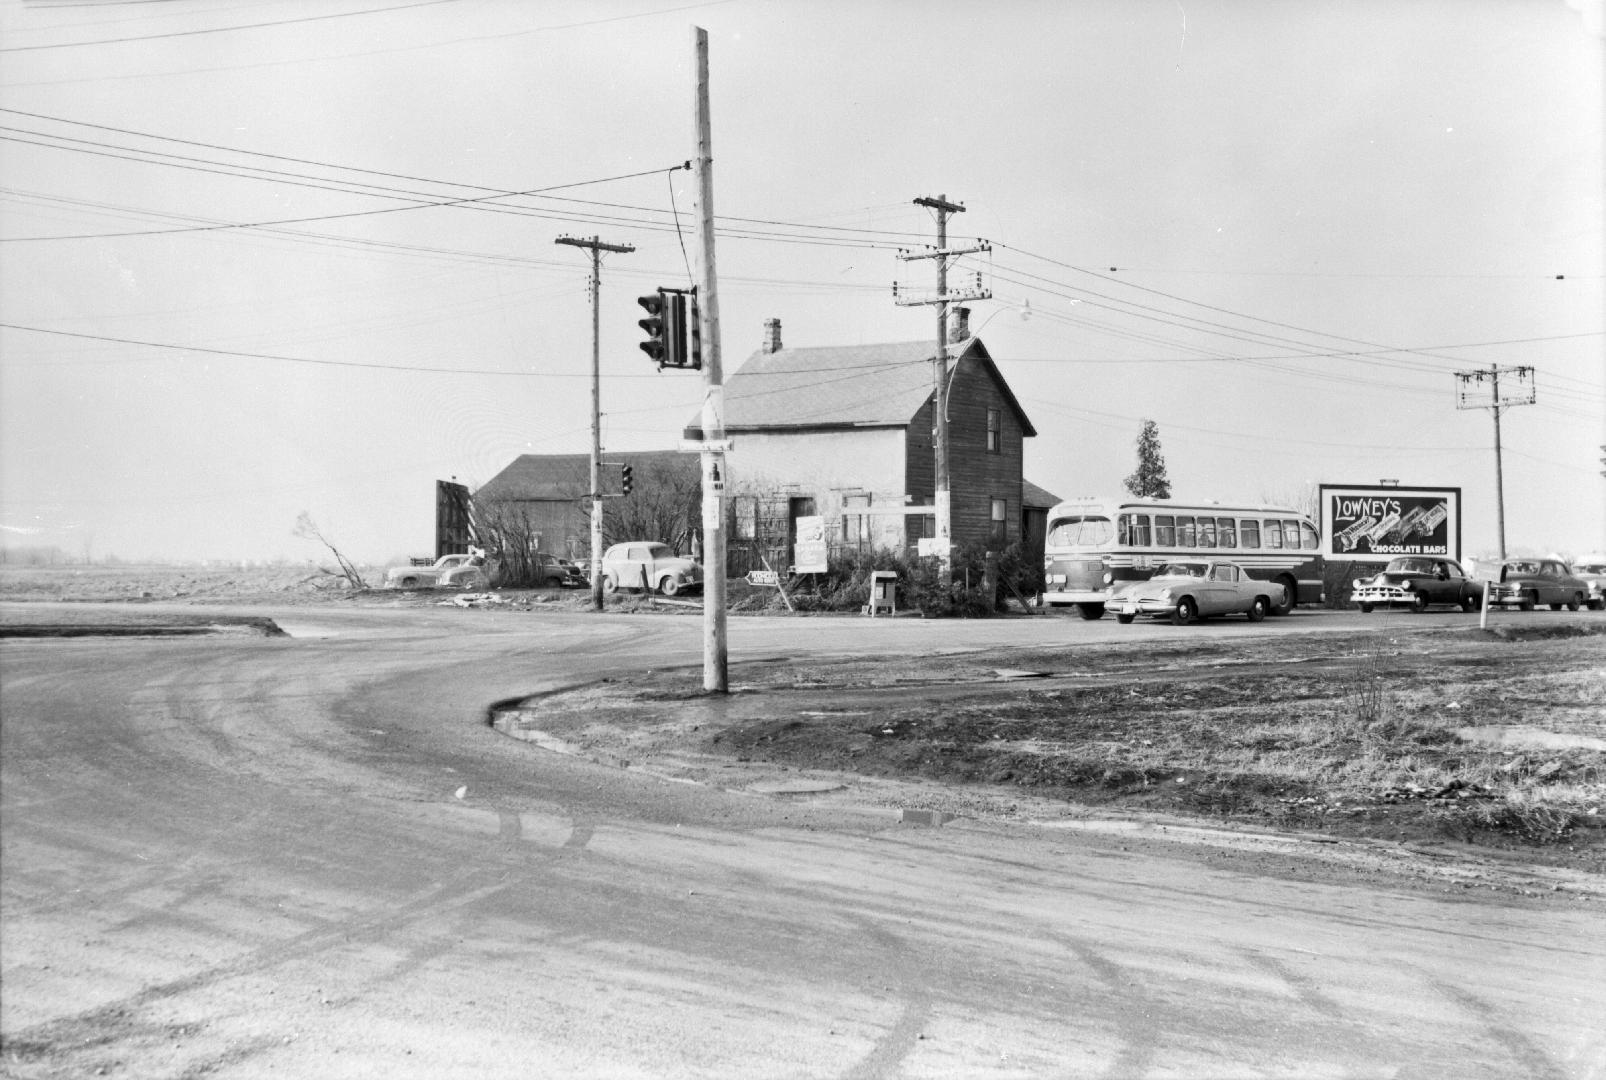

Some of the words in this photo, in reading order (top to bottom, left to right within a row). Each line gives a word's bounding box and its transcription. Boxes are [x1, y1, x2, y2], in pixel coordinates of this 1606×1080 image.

[1335, 496, 1401, 520] LOWNEY'S
[1371, 545, 1420, 553] CHOCOLATE
[1423, 545, 1446, 554] BARS
